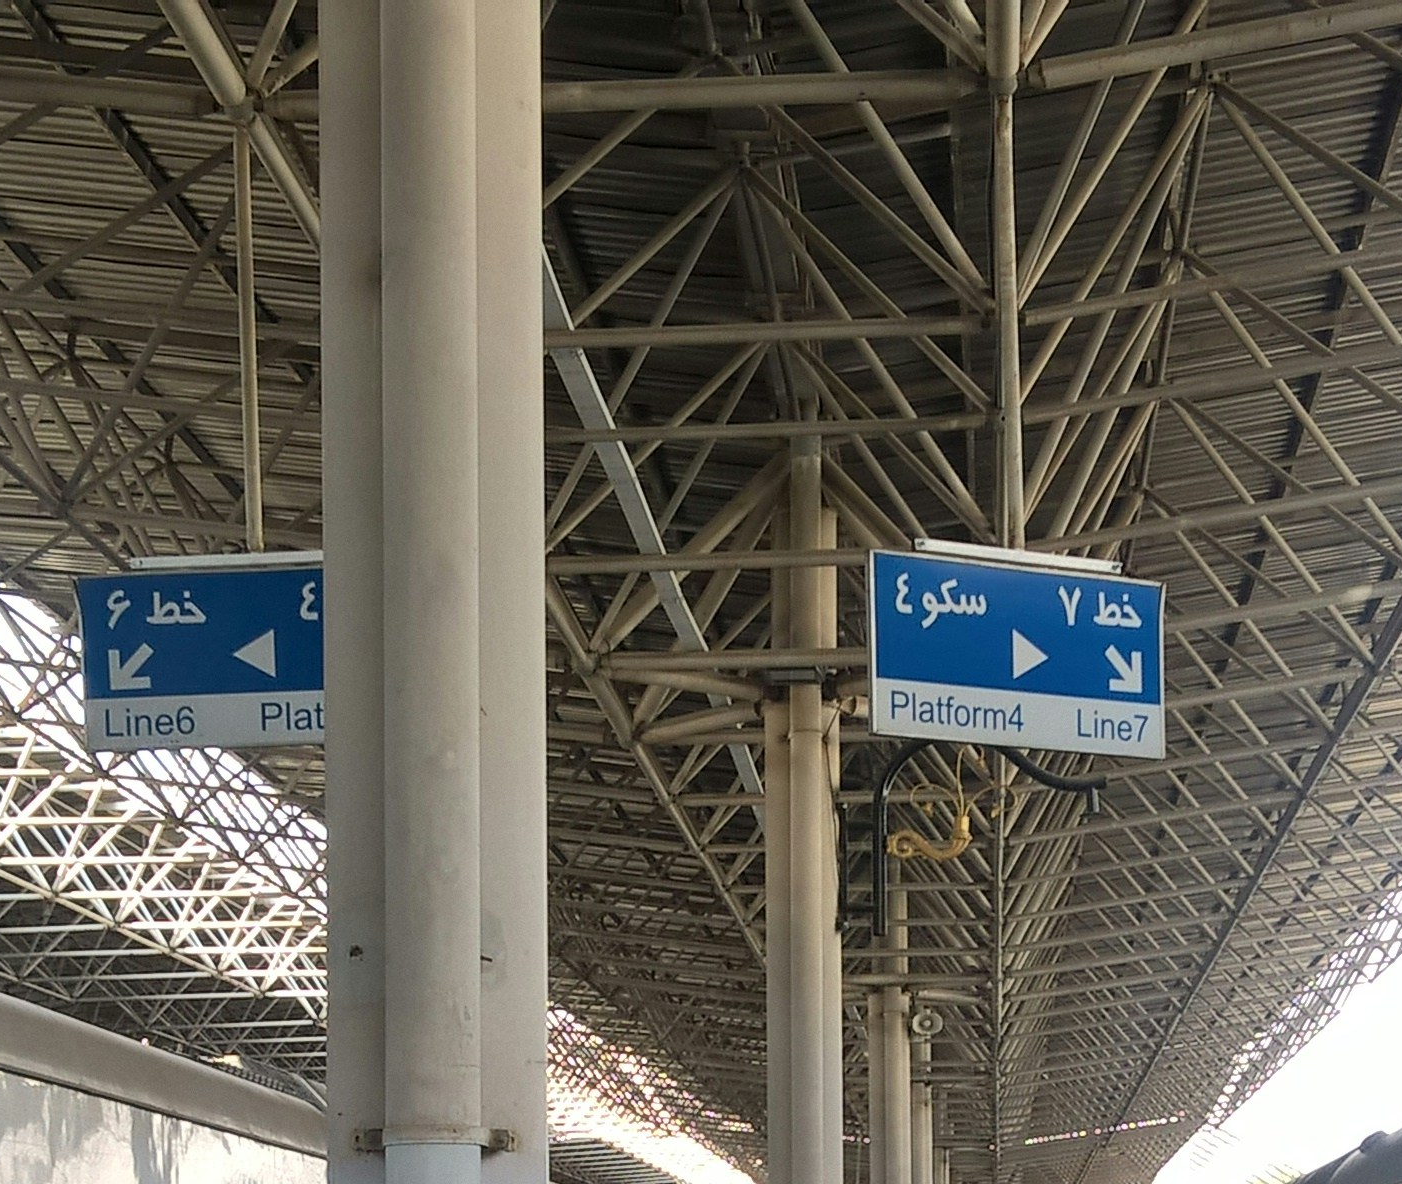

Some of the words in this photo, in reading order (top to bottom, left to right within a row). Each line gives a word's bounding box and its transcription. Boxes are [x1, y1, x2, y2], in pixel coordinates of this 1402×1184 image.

[107, 589, 131, 630] ۶
[146, 590, 207, 624] خط
[921, 578, 988, 630] سکو
[1058, 585, 1082, 627] ۷
[1093, 592, 1143, 628] خط
[104, 706, 195, 738] Line6
[890, 690, 1025, 733] Platform4
[1077, 708, 1149, 743] Line7
